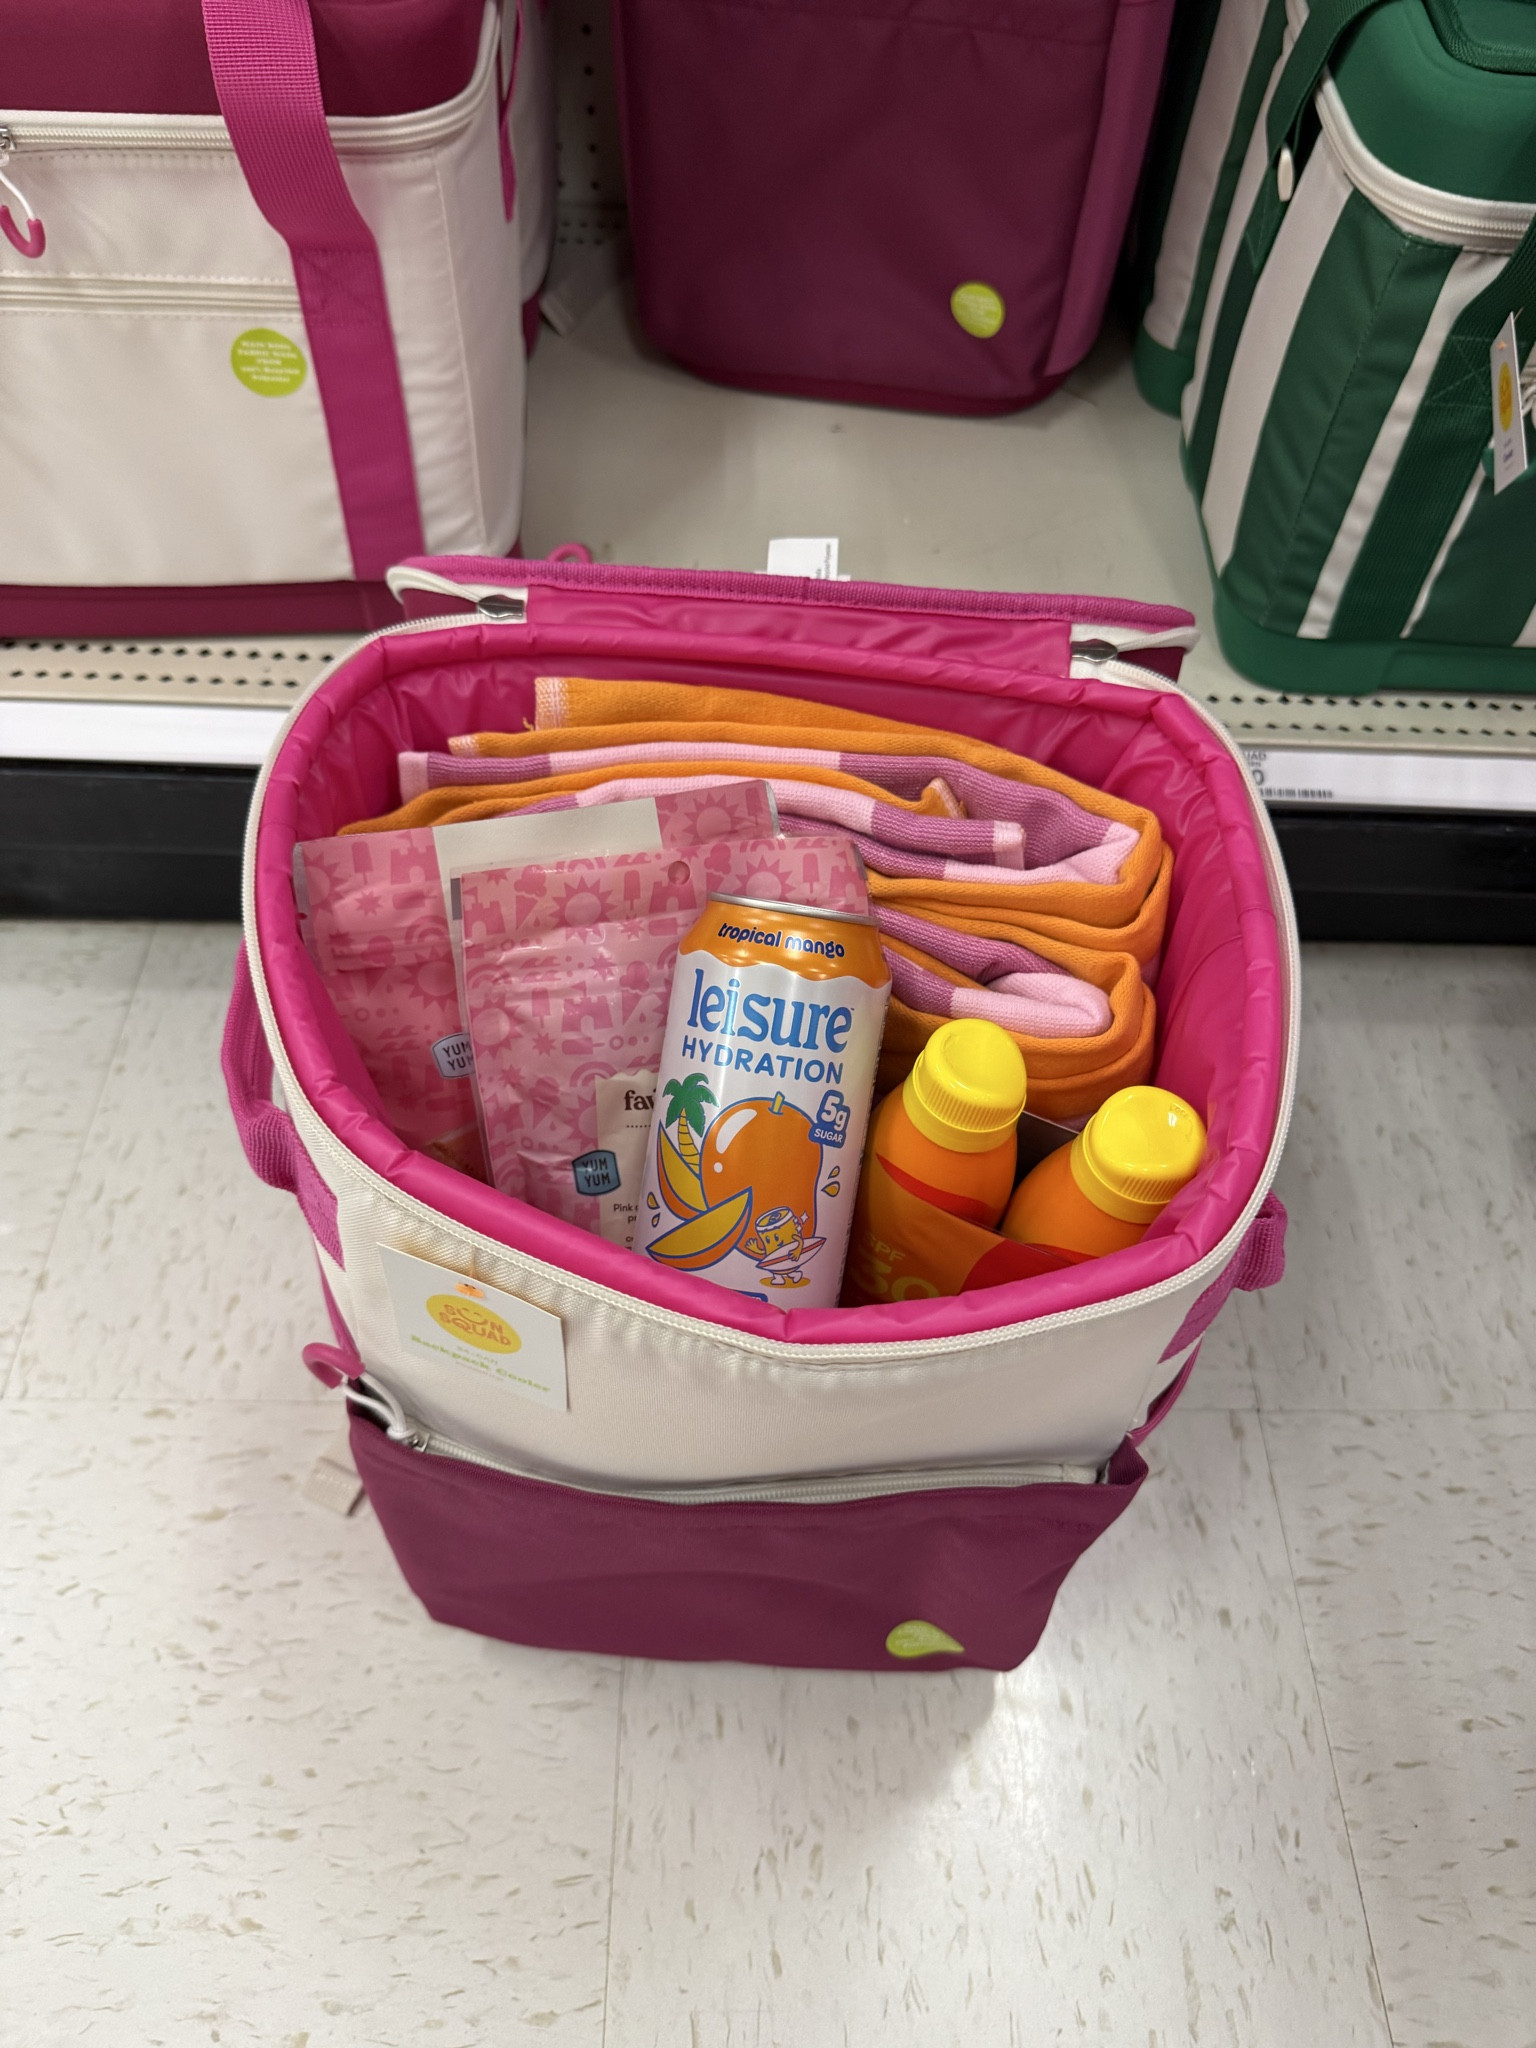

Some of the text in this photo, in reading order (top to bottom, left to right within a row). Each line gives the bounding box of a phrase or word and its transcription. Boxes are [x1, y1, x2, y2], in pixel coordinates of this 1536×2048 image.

[717, 922, 846, 959] tropical mango
[687, 968, 852, 1054] leisure
[681, 1034, 844, 1085] HYDRATION
[820, 1094, 848, 1132] 5g
[813, 1128, 844, 1144] SUGAR
[582, 1157, 608, 1174] YUM
[584, 1173, 611, 1188] YUM
[613, 1204, 633, 1213] Pink
[866, 1232, 906, 1261] SPF
[438, 1311, 512, 1347] SQUAD
[443, 1304, 504, 1334] SUN
